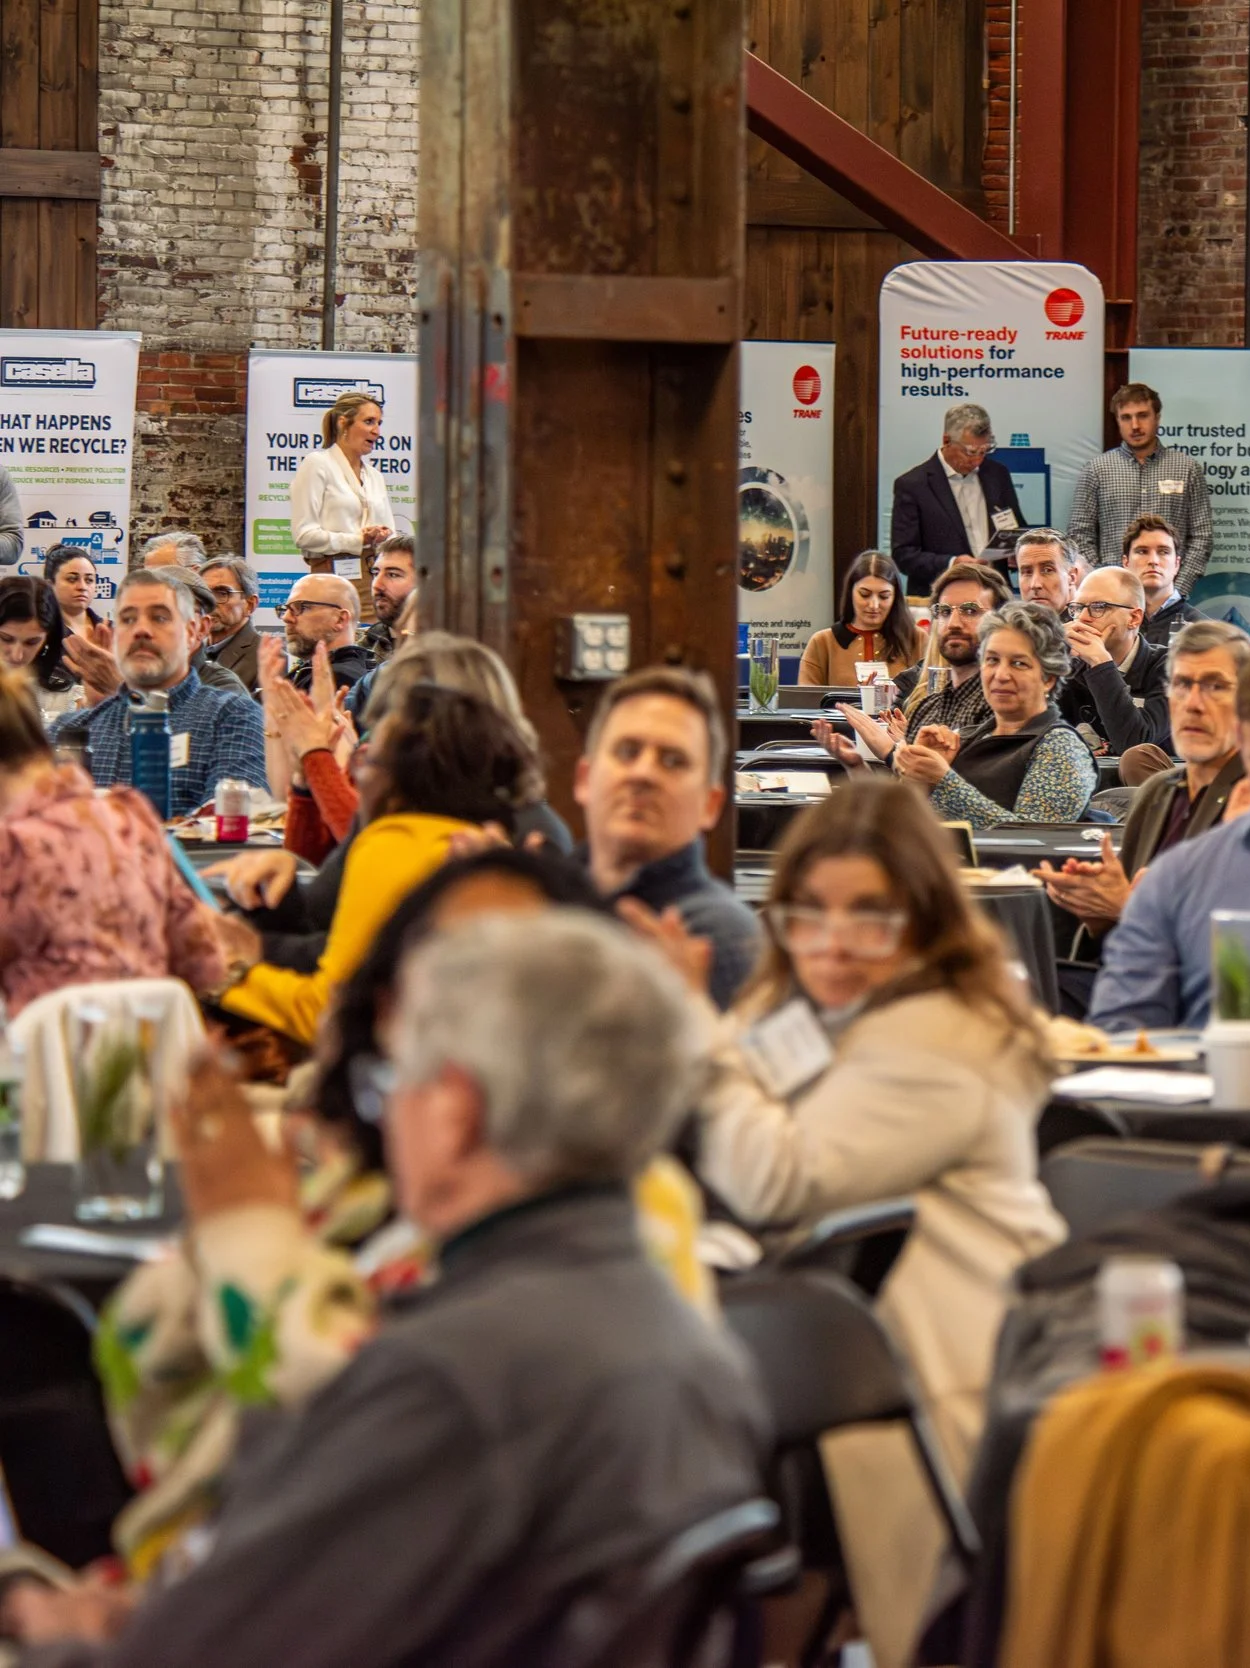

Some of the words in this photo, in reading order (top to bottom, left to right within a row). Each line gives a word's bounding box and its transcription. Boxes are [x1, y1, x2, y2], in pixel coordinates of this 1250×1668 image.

[900, 325, 1018, 344] Future-ready
[1044, 330, 1087, 340] TRANE
[900, 345, 984, 359] solutions
[988, 345, 1016, 360] for
[4, 358, 95, 384] casella
[901, 363, 1065, 381] high-performance
[901, 382, 969, 397] results.
[793, 409, 822, 419] TRANE
[0, 414, 31, 430] HAT
[36, 414, 112, 431] HAPPENS
[1156, 426, 1184, 437] our
[1187, 423, 1246, 437] trusted
[19, 437, 46, 454] WE
[49, 438, 127, 455] RECYCLE?
[266, 432, 309, 449] YOUR
[389, 435, 412, 451] ON
[1210, 442, 1234, 456] for
[267, 456, 297, 471] THE
[370, 458, 411, 474] ZERO
[784, 619, 812, 629] insights
[779, 632, 796, 640] your
